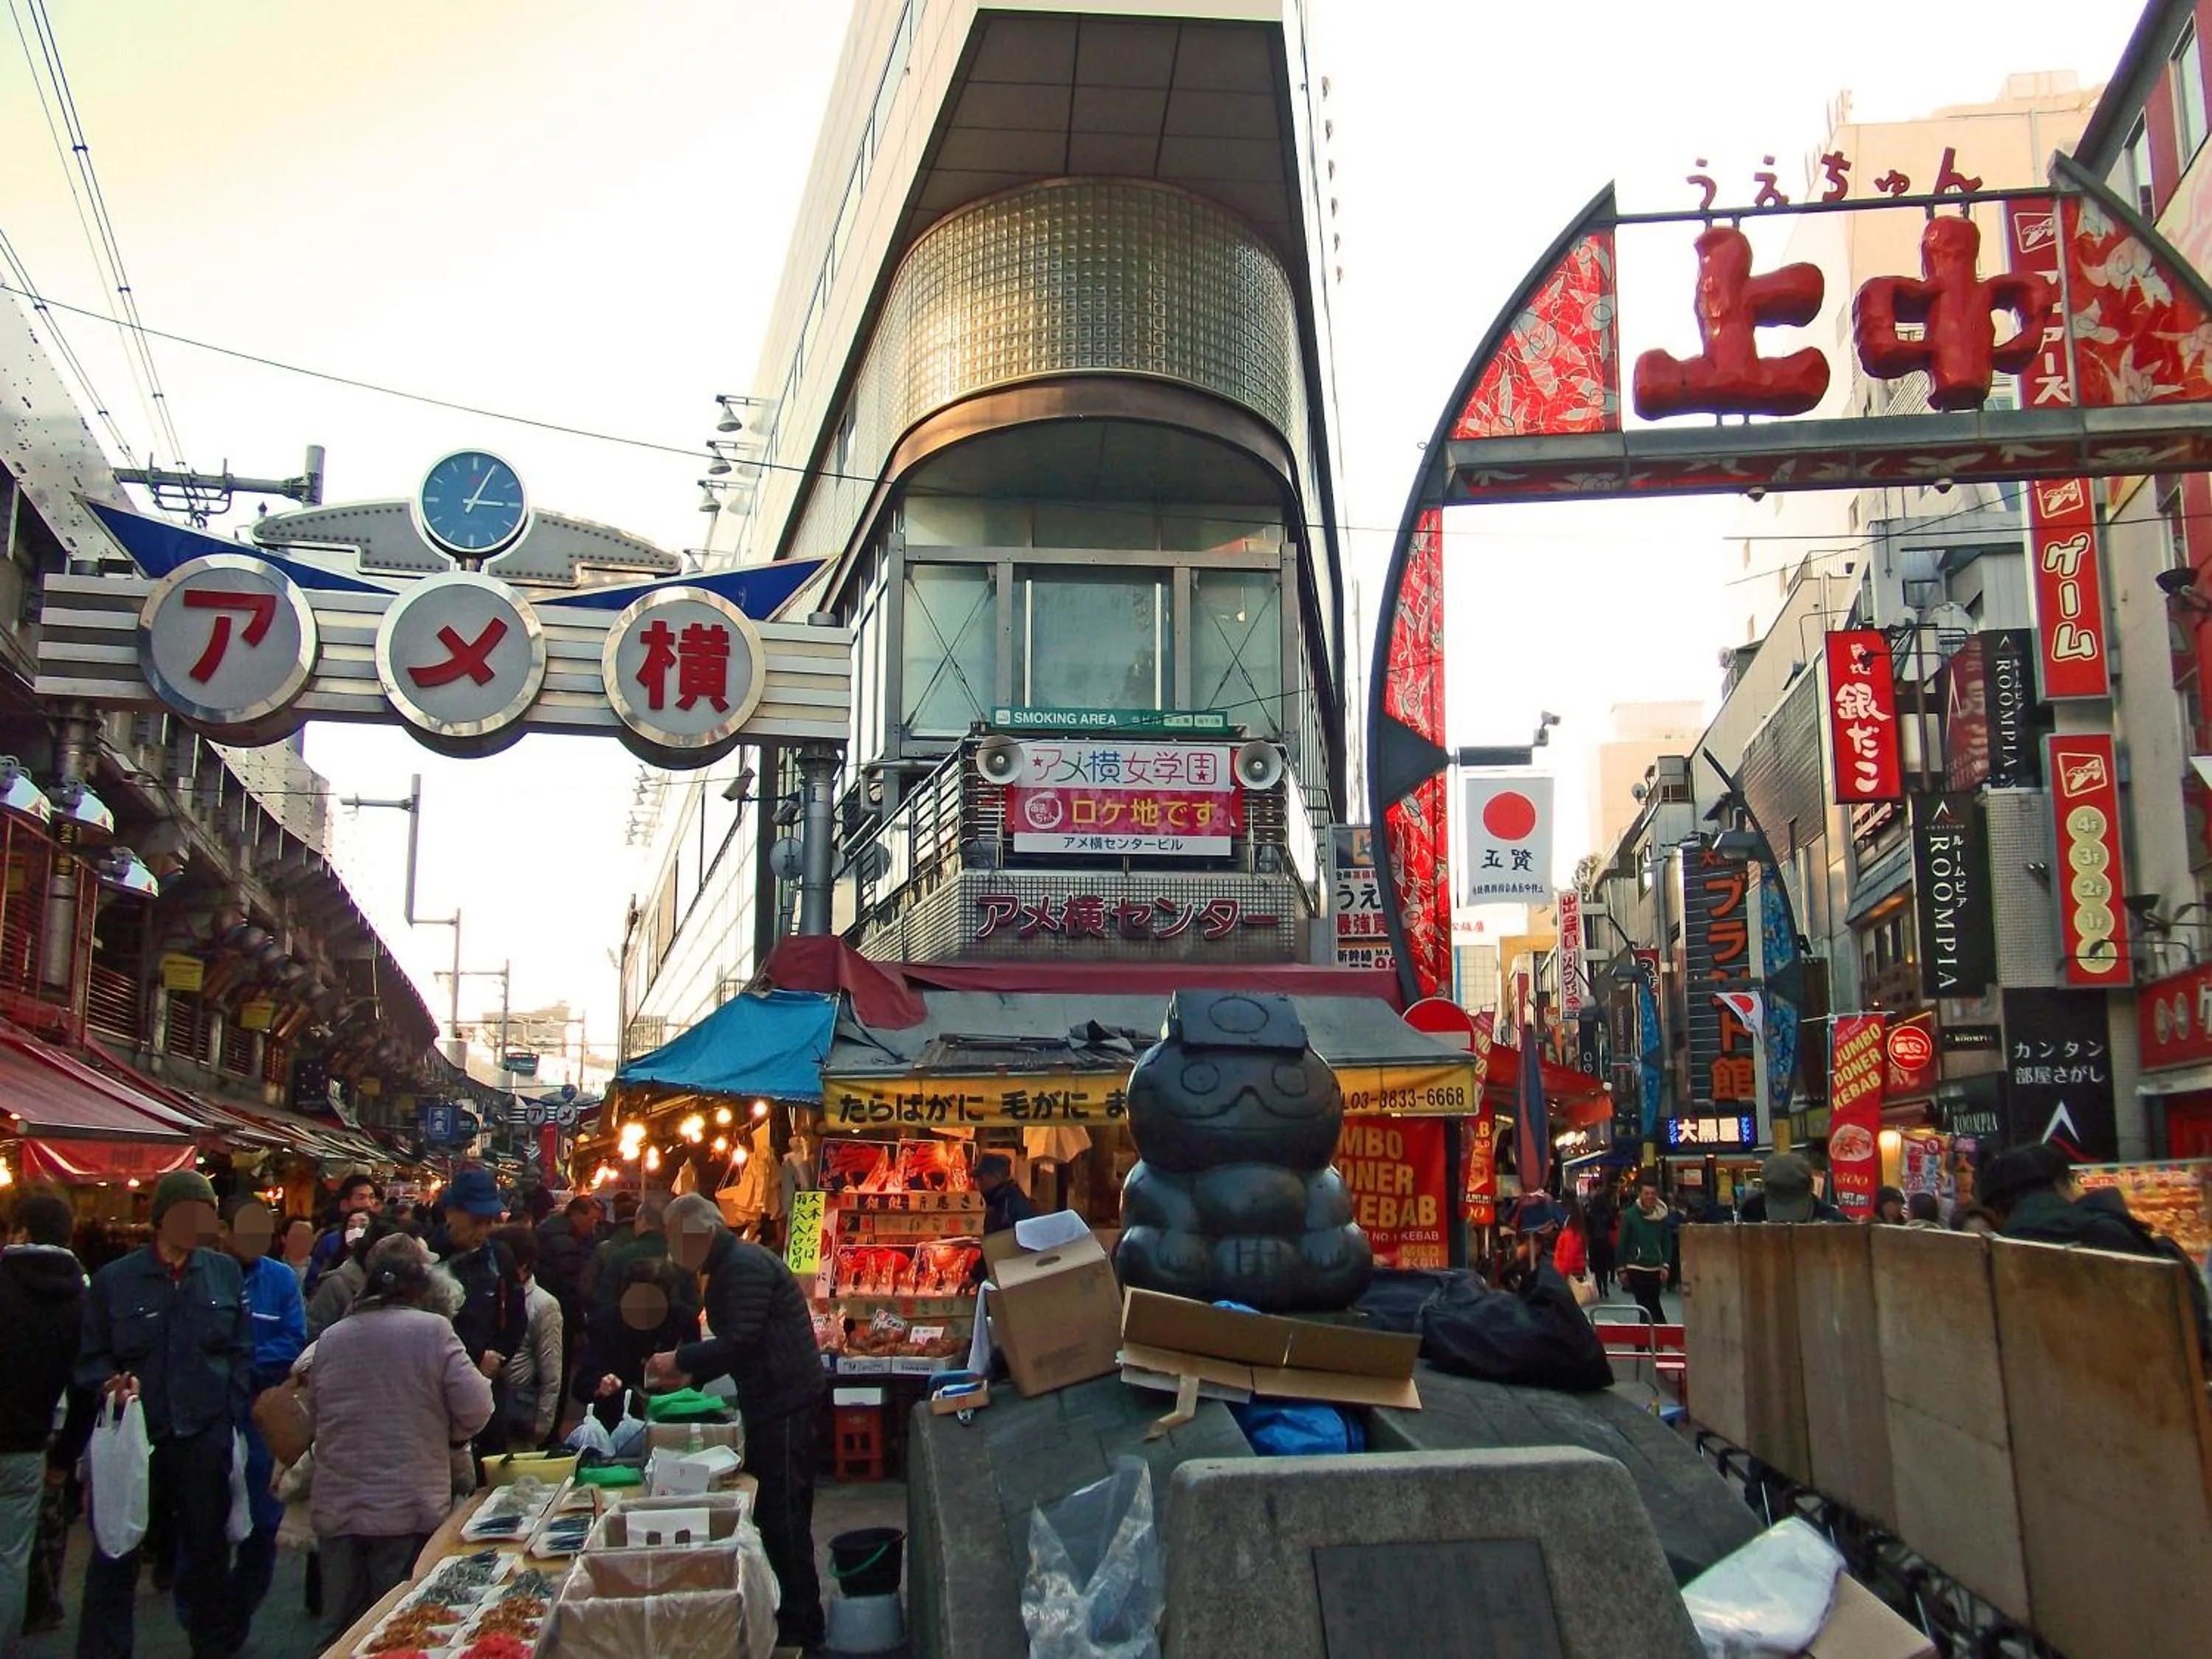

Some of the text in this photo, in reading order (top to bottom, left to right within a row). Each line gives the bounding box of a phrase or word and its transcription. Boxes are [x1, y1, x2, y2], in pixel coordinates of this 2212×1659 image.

[1633, 215, 2057, 422] 上中
[2042, 532, 2097, 661] ゲーム
[184, 589, 730, 713] アメ横
[1014, 712, 1117, 725] SMOKING AREA
[1996, 659, 2017, 768] ROOMPIA
[1835, 682, 1891, 793] 銀だこ
[1032, 748, 1217, 785] アメ横女学園
[1072, 797, 1217, 827] ロケ地です
[2076, 821, 2098, 833] 4F
[1063, 836, 1183, 851] アメ横センタービル
[2079, 848, 2101, 865] 3F
[1953, 835, 1968, 908] ルームピア
[2081, 880, 2104, 897] 2F
[977, 894, 1279, 942] アメ横センター
[1930, 836, 1958, 989] ROOMPIA
[2086, 912, 2104, 930] 1F
[1836, 1023, 1882, 1067] JUMBO
[2014, 1040, 2105, 1060] カンタン
[1834, 1047, 1882, 1088] DONER
[2015, 1065, 2105, 1085] 部屋さがし
[839, 1092, 984, 1122] たらばがに
[1002, 1091, 1088, 1119] 毛がに
[1832, 1071, 1882, 1111] KEBAB
[1677, 1117, 1739, 1143] 大黒屋
[1400, 1230, 1439, 1242] KEBAB
